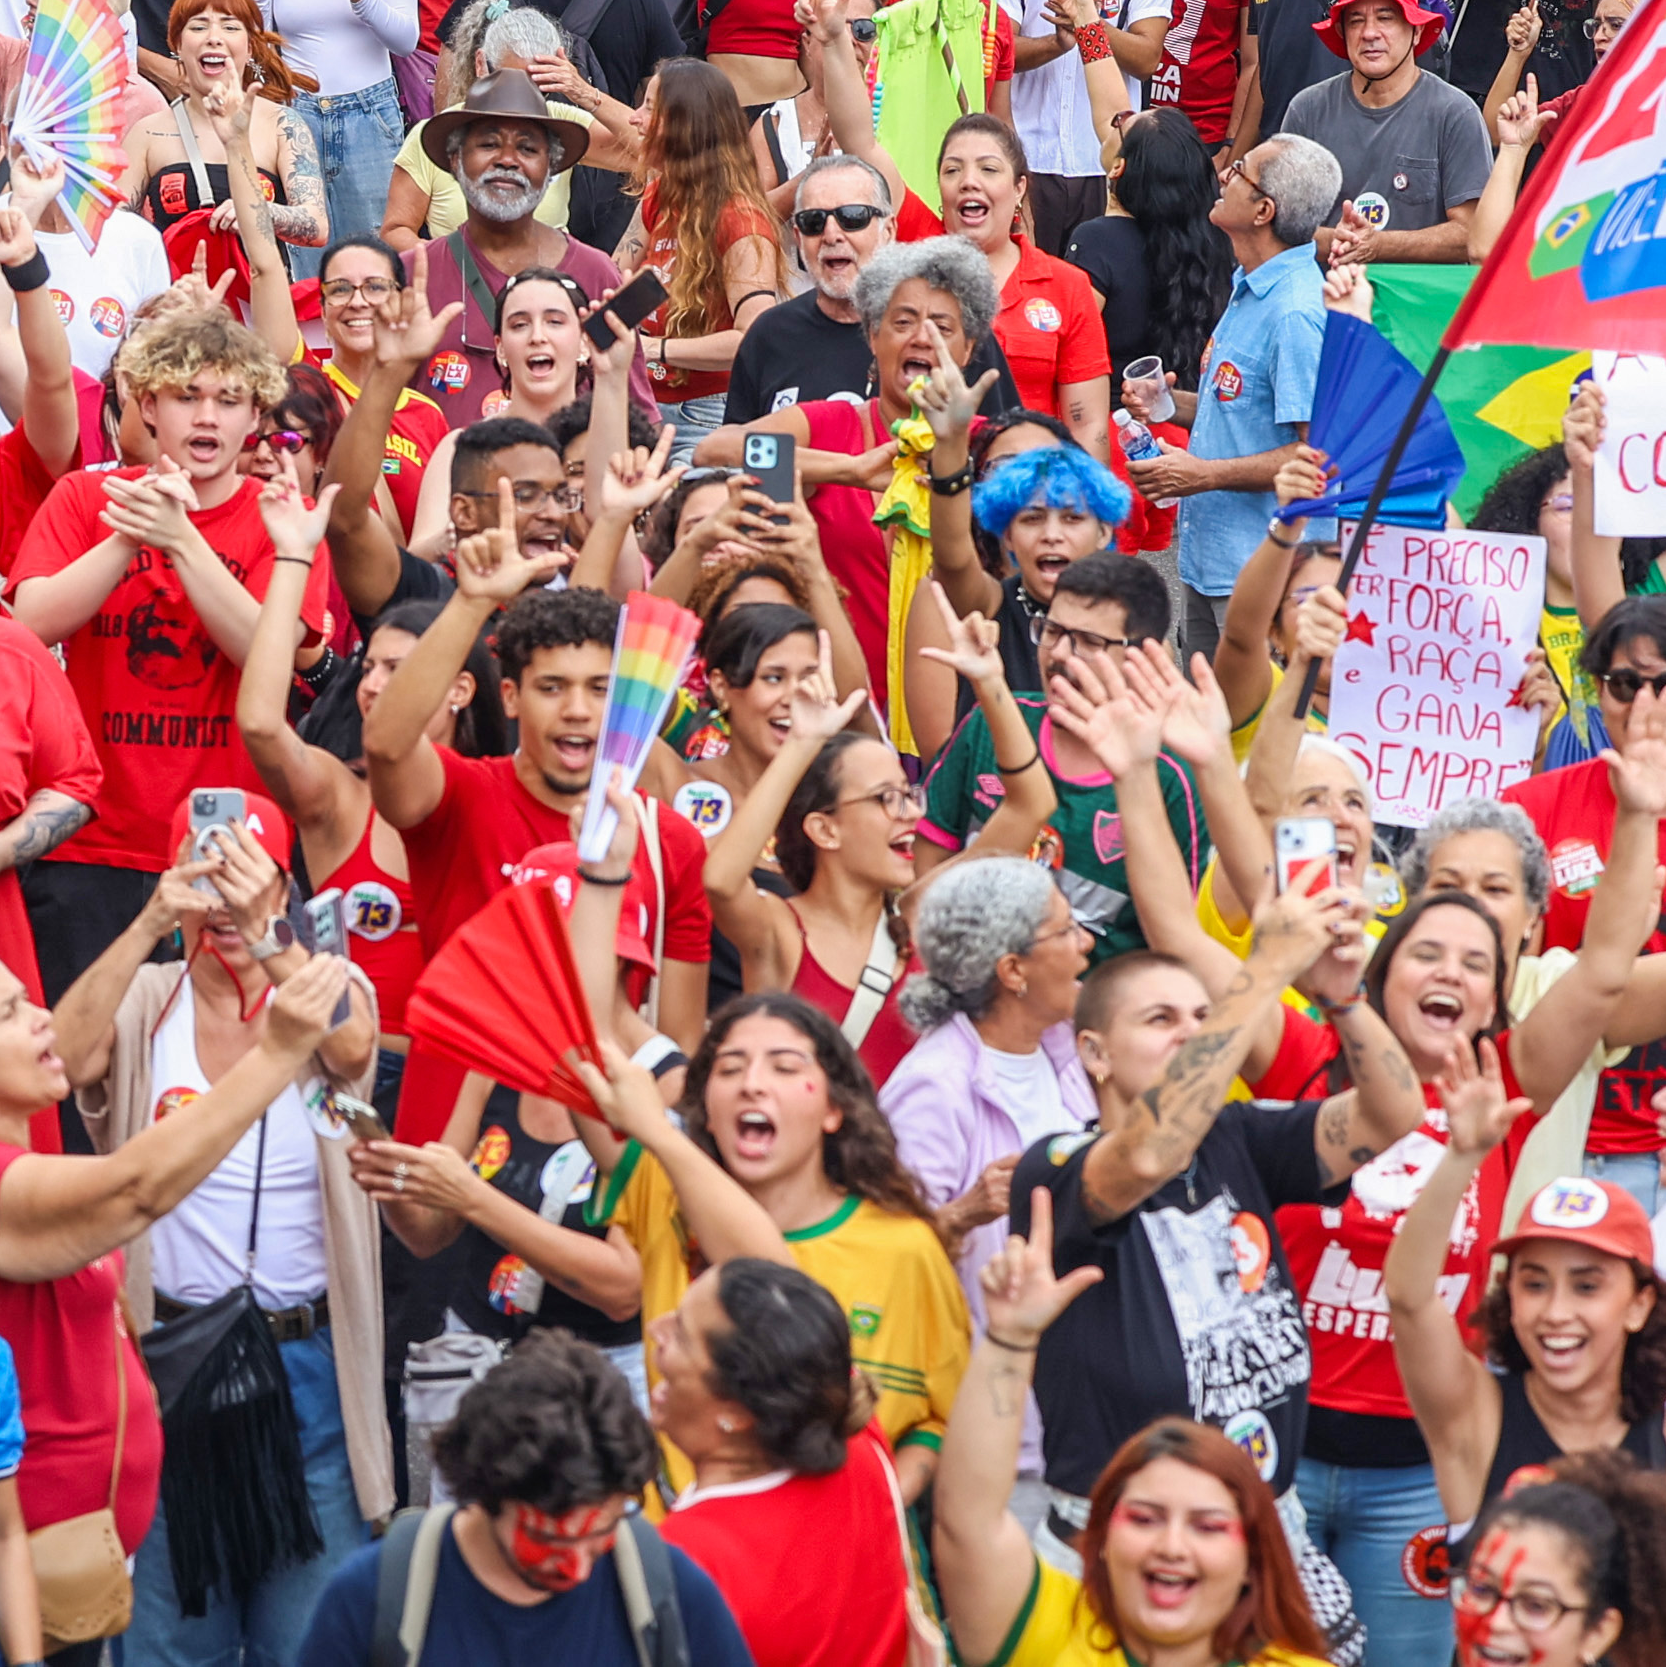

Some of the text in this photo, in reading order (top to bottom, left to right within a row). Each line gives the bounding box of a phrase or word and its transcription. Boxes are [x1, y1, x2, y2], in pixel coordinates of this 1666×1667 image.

[1360, 205, 1384, 224] 13
[1402, 535, 1530, 592] PRECISO
[1388, 634, 1504, 695] RAÇA
[101, 711, 232, 749] COMMUNIST
[1344, 668, 1504, 749] e GANA
[357, 901, 393, 929] 13
